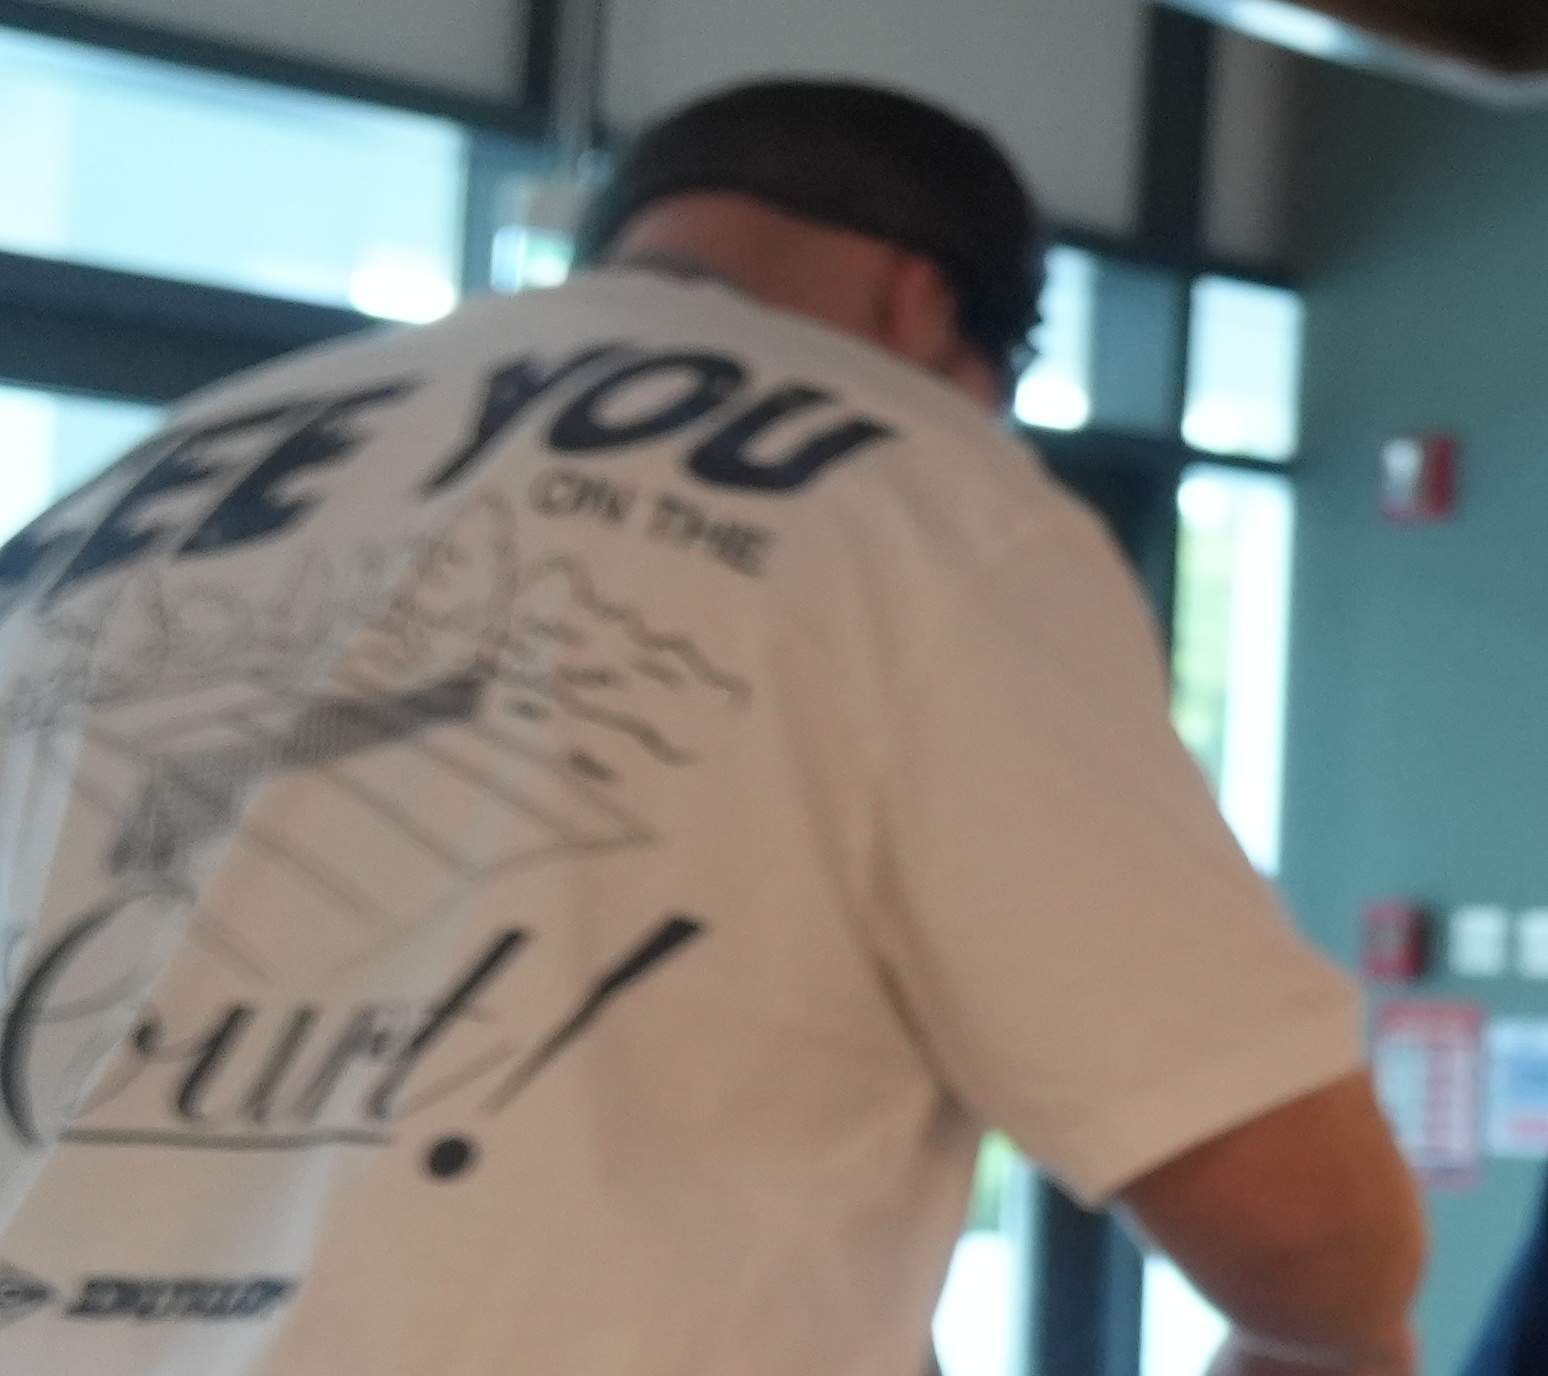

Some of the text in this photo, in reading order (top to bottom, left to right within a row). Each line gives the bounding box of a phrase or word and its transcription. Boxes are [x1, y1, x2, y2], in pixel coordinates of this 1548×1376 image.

[420, 342, 898, 502] YOU
[528, 468, 778, 579] ON THE
